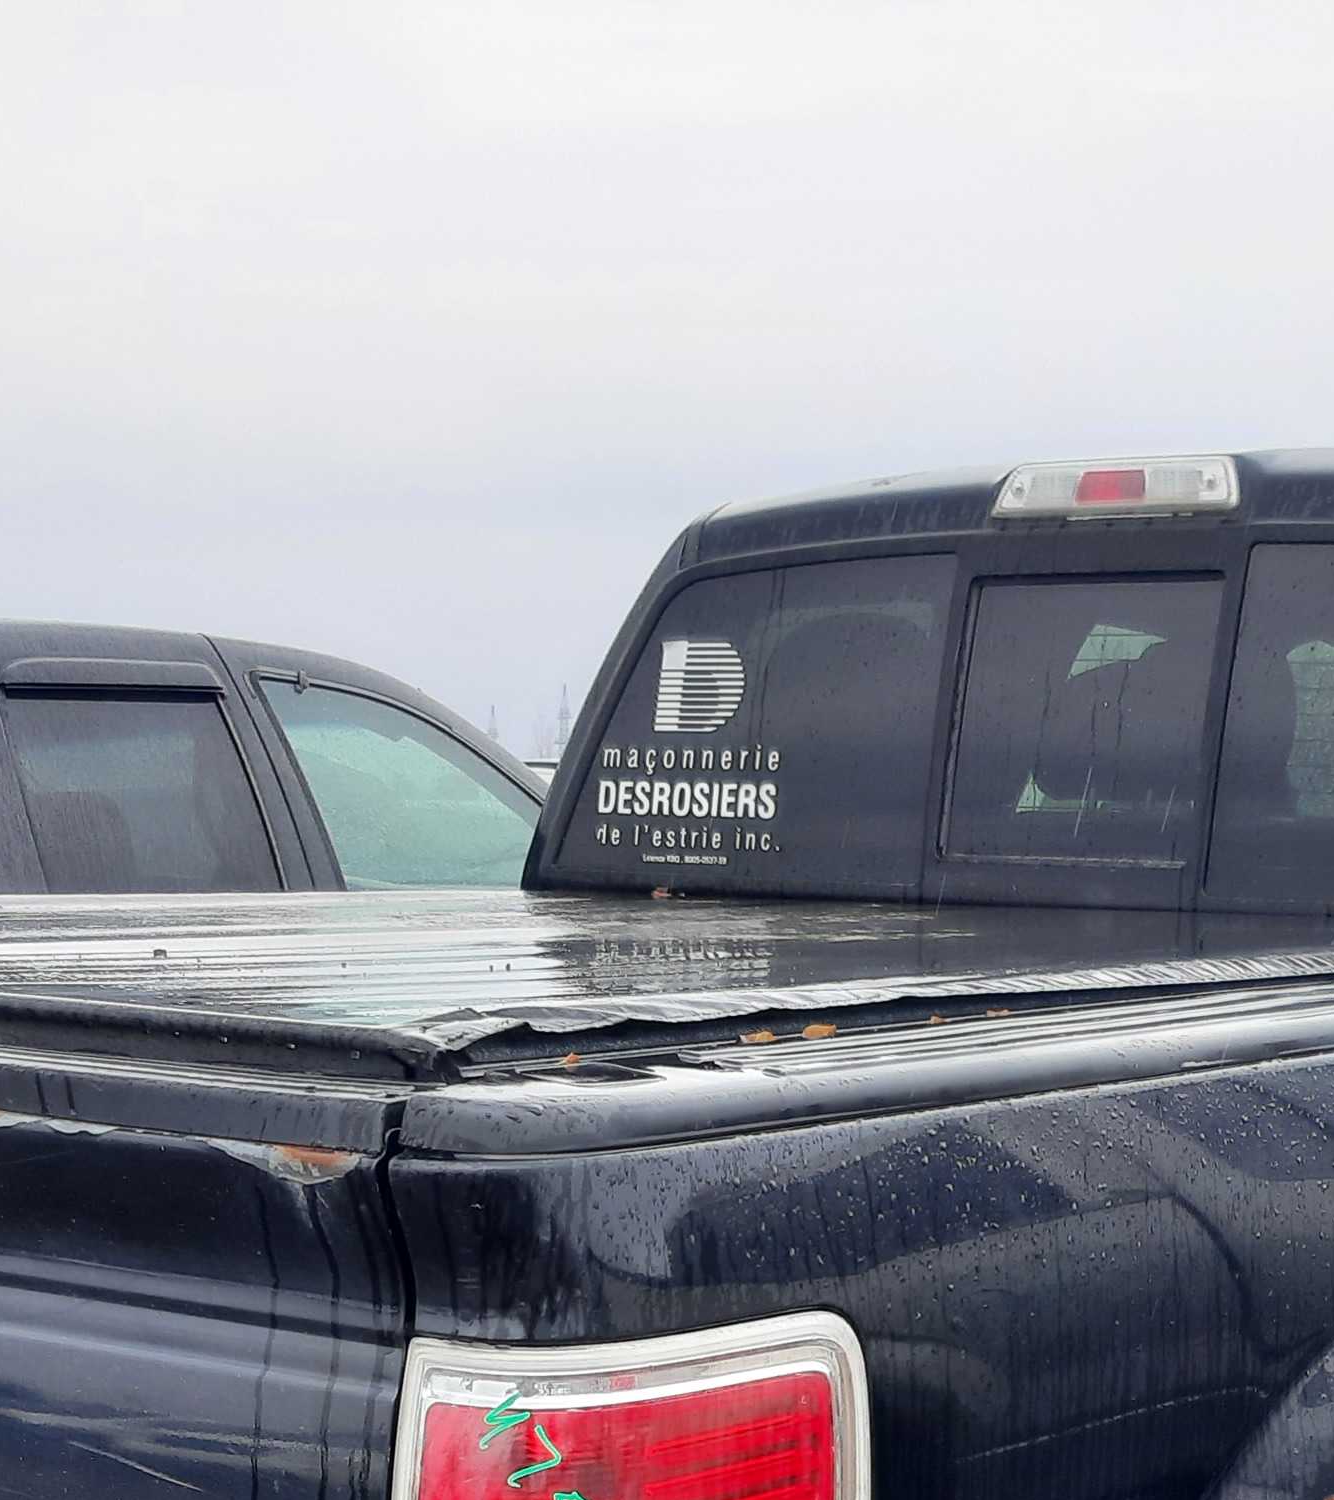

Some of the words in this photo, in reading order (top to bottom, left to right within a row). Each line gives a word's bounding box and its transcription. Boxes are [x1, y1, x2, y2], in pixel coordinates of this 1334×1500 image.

[602, 744, 781, 775] maçonnerie
[597, 779, 777, 820] DESROSIERS
[596, 823, 620, 846] de
[634, 824, 723, 849] l'estrie
[734, 827, 781, 851] inc.
